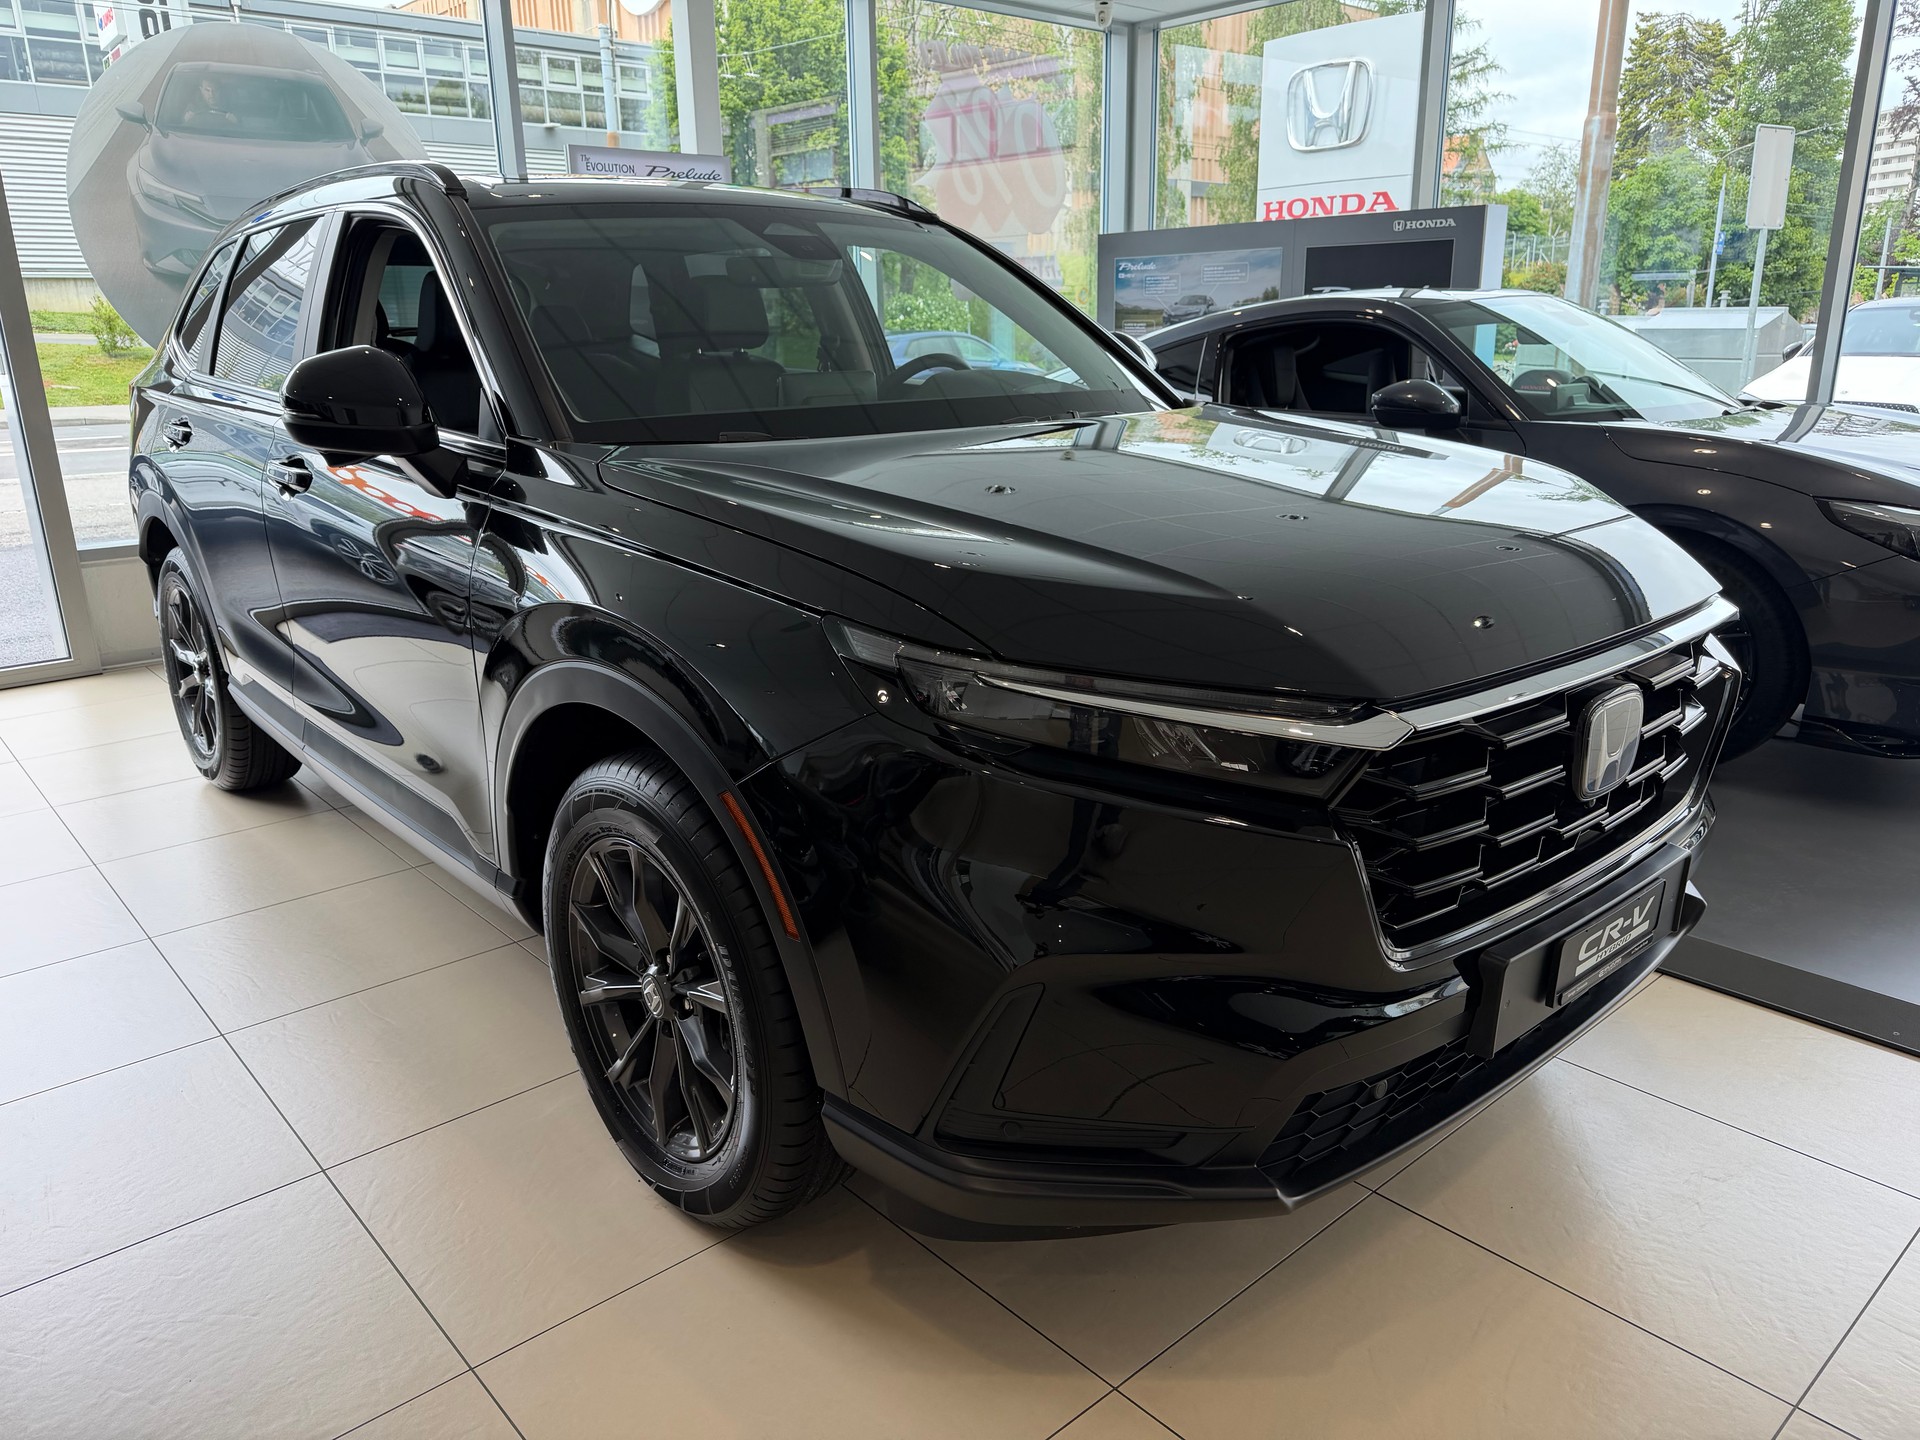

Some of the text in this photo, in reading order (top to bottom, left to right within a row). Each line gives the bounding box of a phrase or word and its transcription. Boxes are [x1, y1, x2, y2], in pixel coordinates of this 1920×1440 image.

[580, 154, 590, 162] The
[645, 164, 722, 181] Prelude
[1262, 191, 1400, 221] HONDA
[1405, 218, 1457, 230] HONDA
[1118, 261, 1157, 271] Prelude
[1578, 895, 1655, 962] CR-V
[1595, 933, 1632, 962] HYBRID
[716, 942, 758, 1098] DUNLOP
